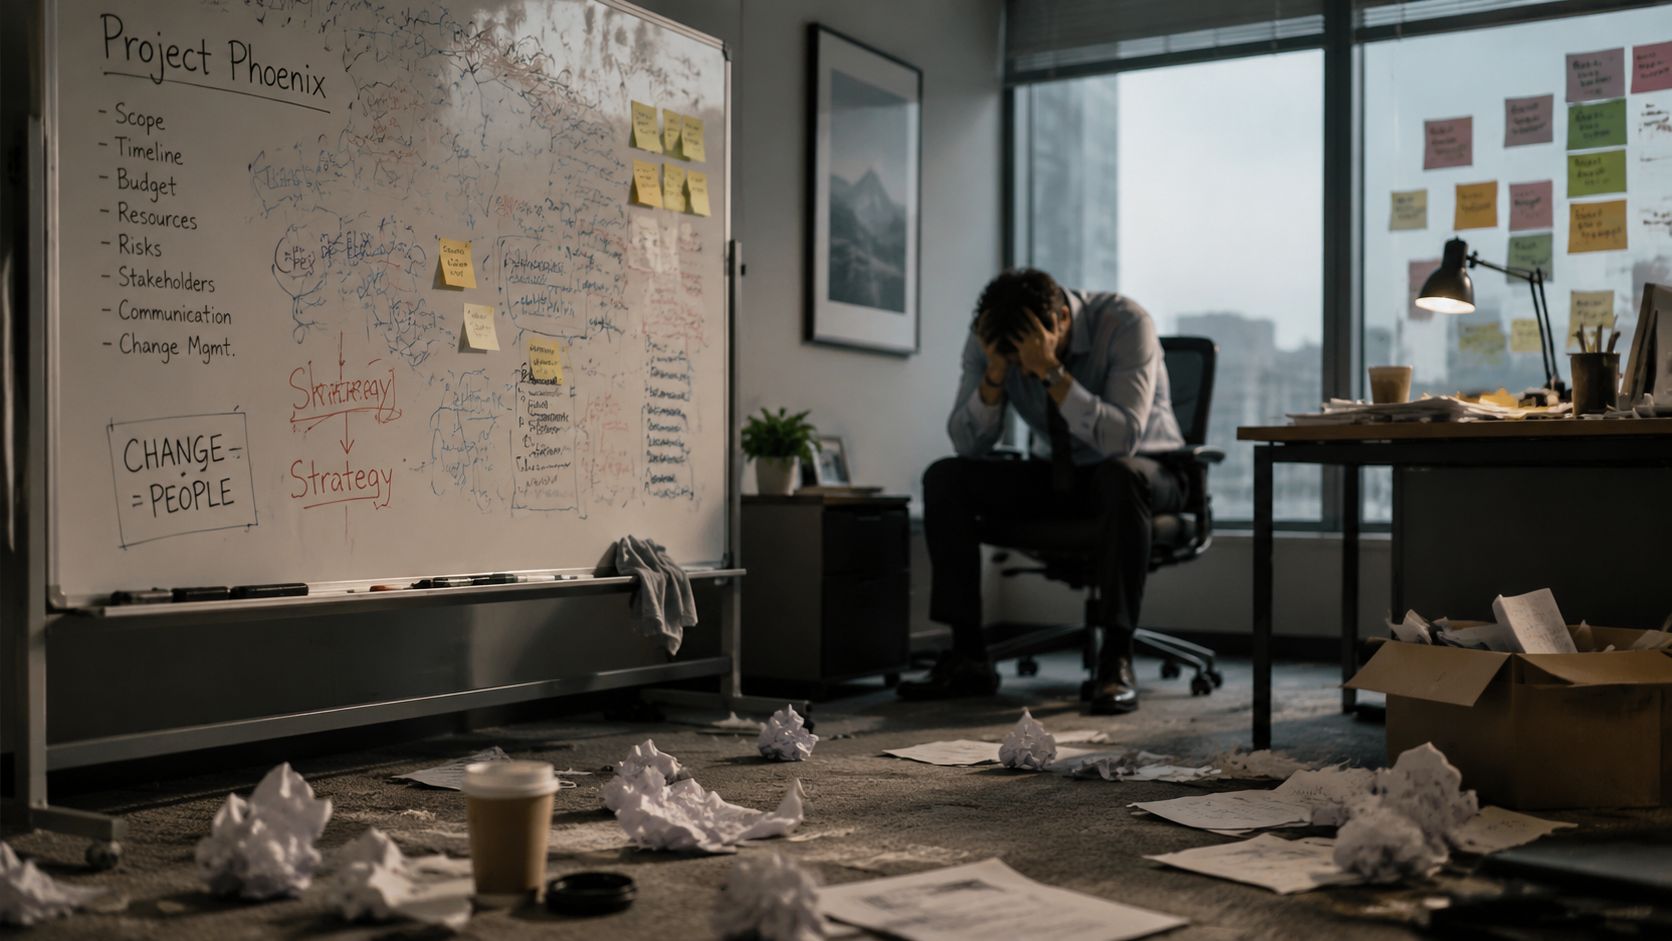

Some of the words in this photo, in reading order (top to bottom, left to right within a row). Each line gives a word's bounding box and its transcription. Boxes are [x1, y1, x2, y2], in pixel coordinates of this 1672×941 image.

[99, 13, 212, 85] Project
[228, 40, 326, 98] Phoenix
[114, 102, 166, 135] Scope
[114, 136, 184, 166] Timeline
[117, 167, 177, 203] Budget
[118, 201, 198, 230] Resources
[118, 233, 163, 257] Risks
[118, 265, 216, 294] Stakeholders
[118, 299, 232, 325] Communication
[119, 332, 179, 364] Change
[187, 335, 236, 365] Mgmt.
[149, 477, 236, 518] PEOPLE
[290, 459, 393, 508] Strategy
